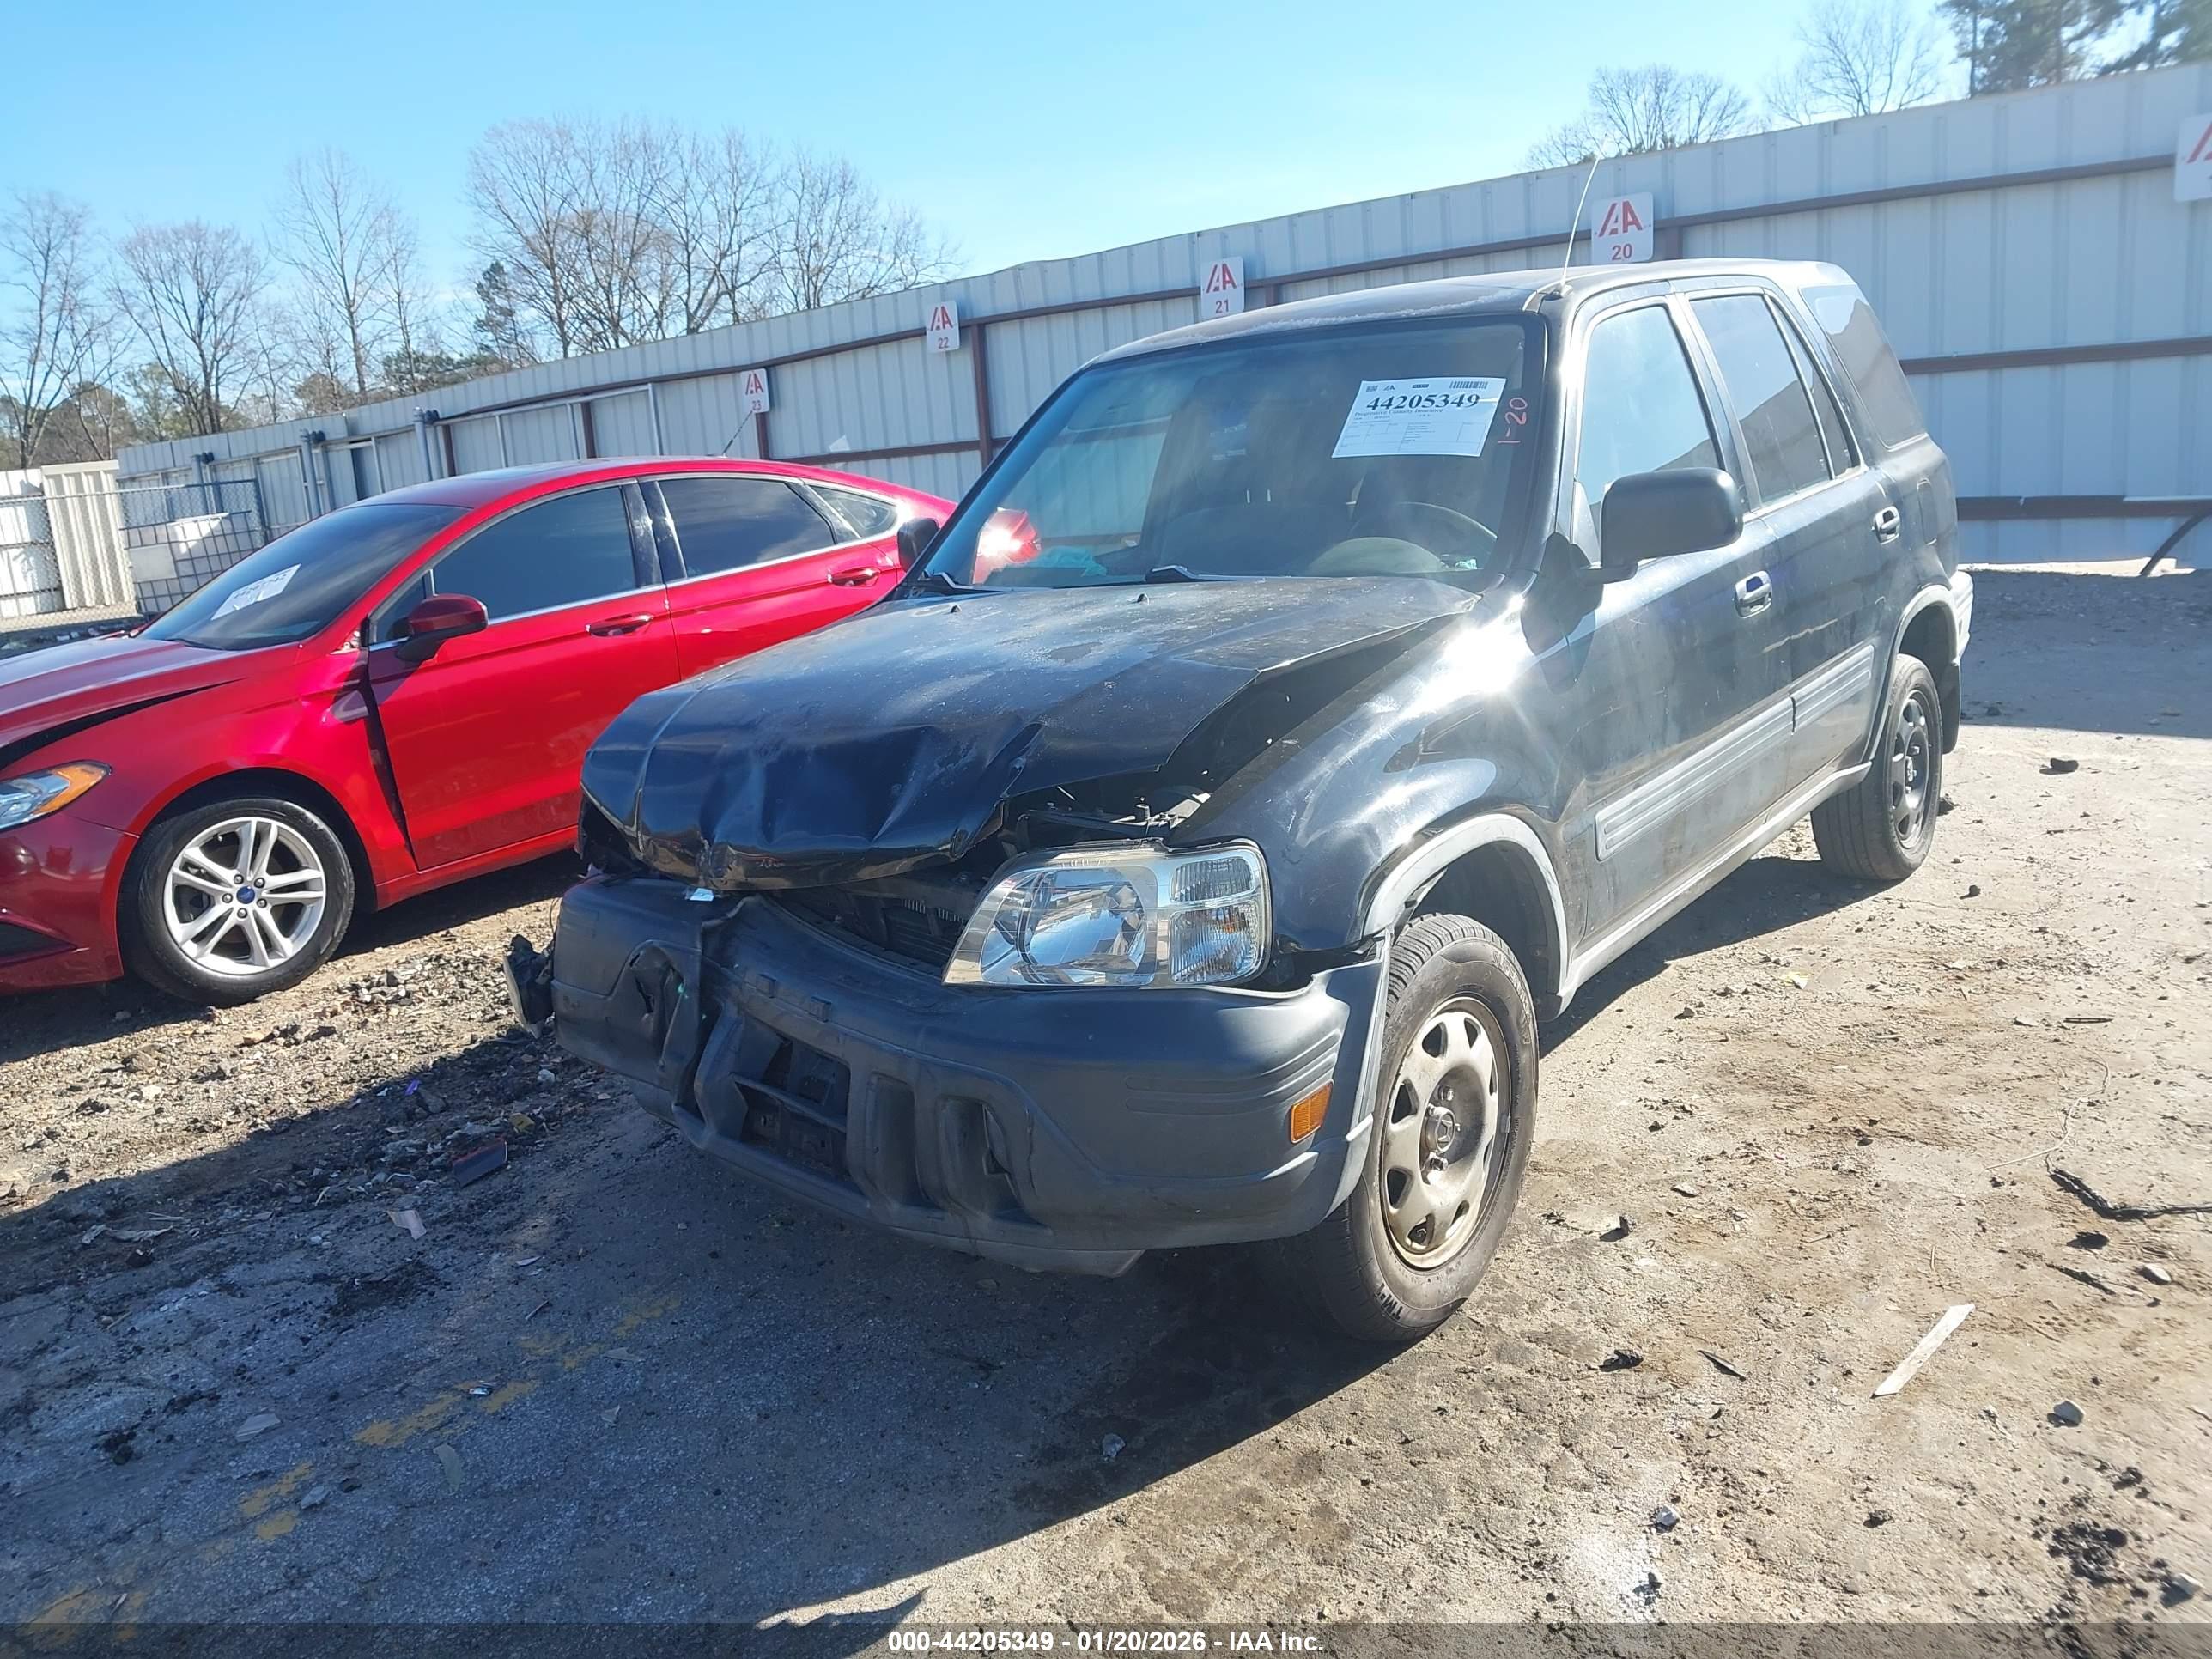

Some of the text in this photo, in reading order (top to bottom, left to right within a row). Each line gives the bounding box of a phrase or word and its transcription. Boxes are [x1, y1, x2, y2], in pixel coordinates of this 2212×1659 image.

[1612, 243, 1632, 260] 20
[1215, 299, 1229, 313] 21
[938, 337, 949, 349] 22
[1366, 394, 1480, 410] 44205349
[1498, 398, 1528, 443] 1-20
